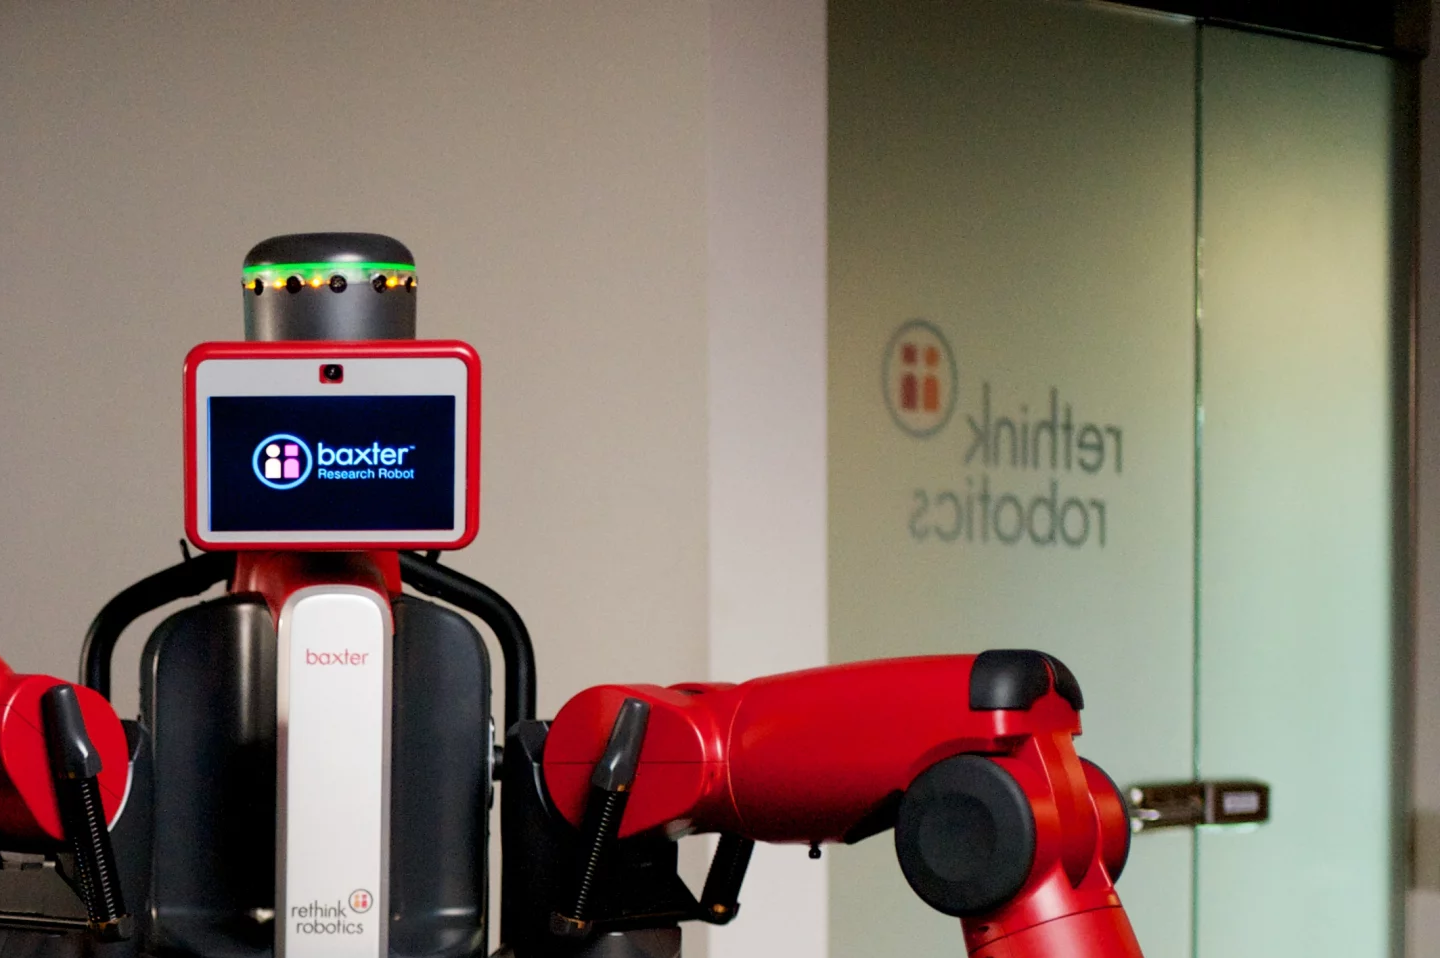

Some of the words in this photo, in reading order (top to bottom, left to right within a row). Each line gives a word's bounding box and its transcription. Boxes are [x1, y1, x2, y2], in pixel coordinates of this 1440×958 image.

[317, 467, 375, 480] Research
[378, 467, 415, 480] Robot
[305, 647, 369, 666] baxter
[290, 899, 348, 919] rethink
[296, 919, 364, 935] robotics
